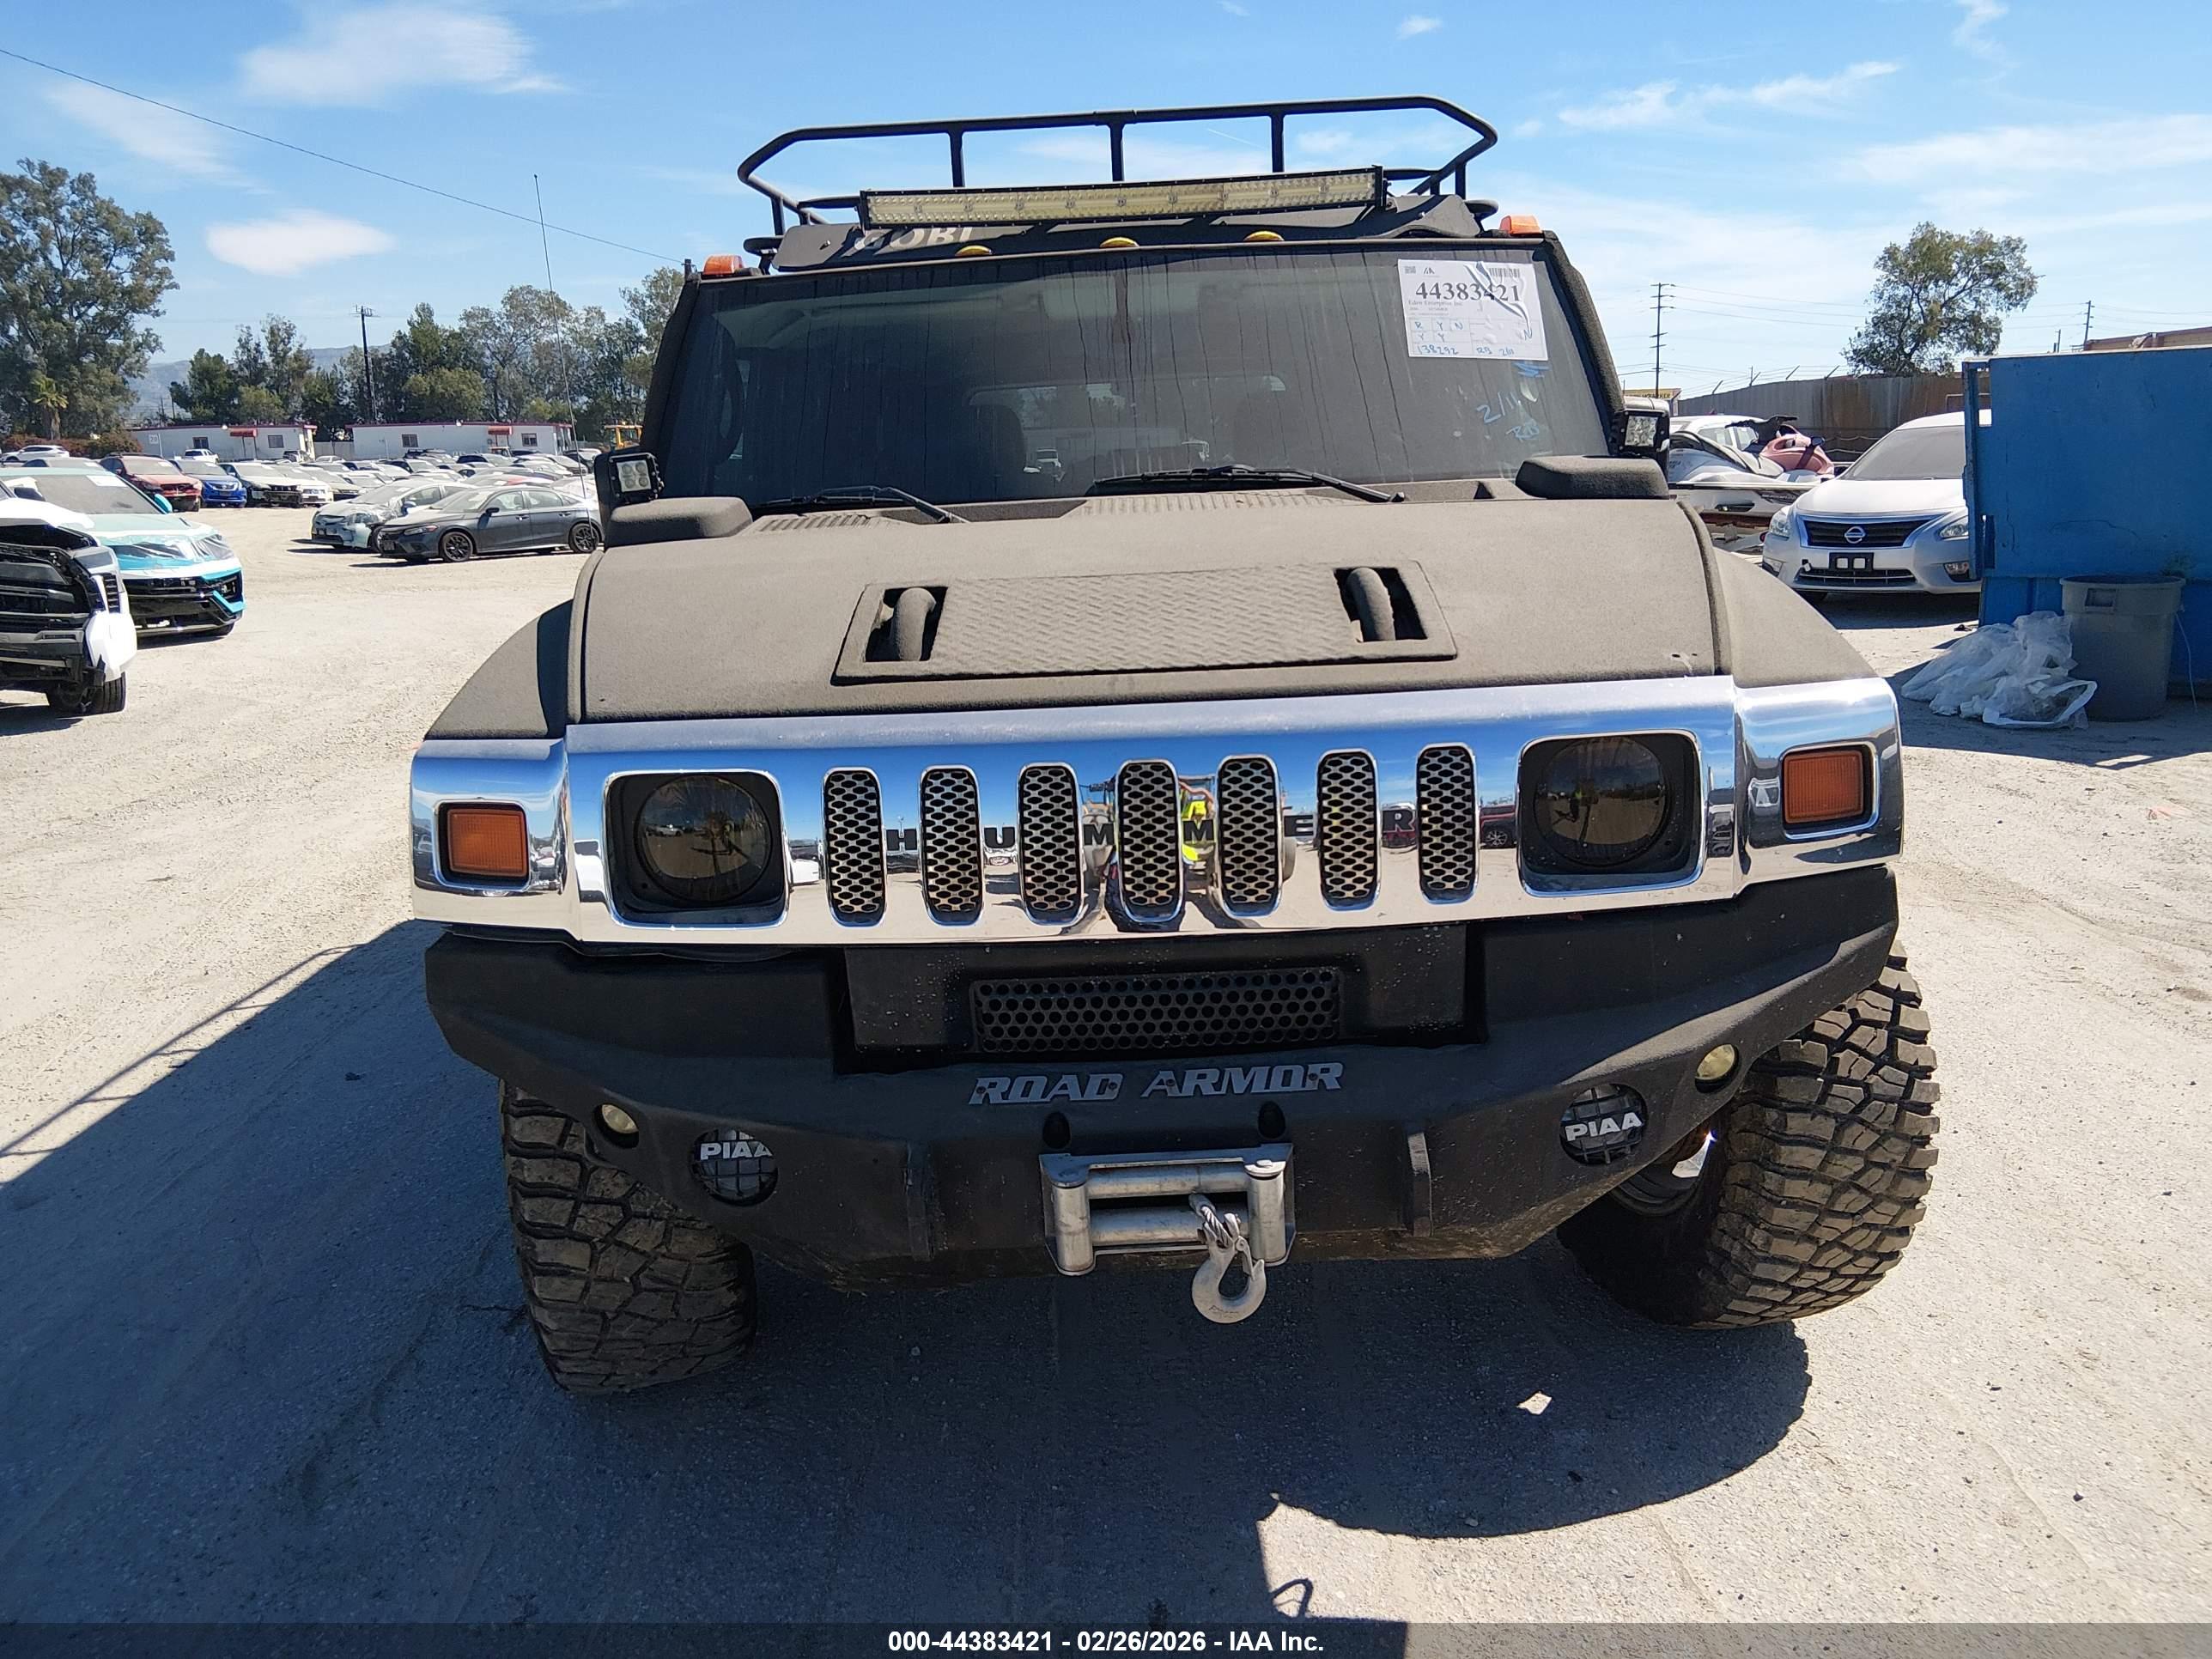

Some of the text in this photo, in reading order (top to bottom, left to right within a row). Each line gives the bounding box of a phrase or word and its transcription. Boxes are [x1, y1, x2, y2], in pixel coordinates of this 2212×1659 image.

[1415, 282, 1520, 302] 44383421
[968, 1061, 1345, 1105] ROAD ARMOR
[1565, 1111, 1644, 1142] PIAA
[700, 1140, 774, 1161] PIAA
